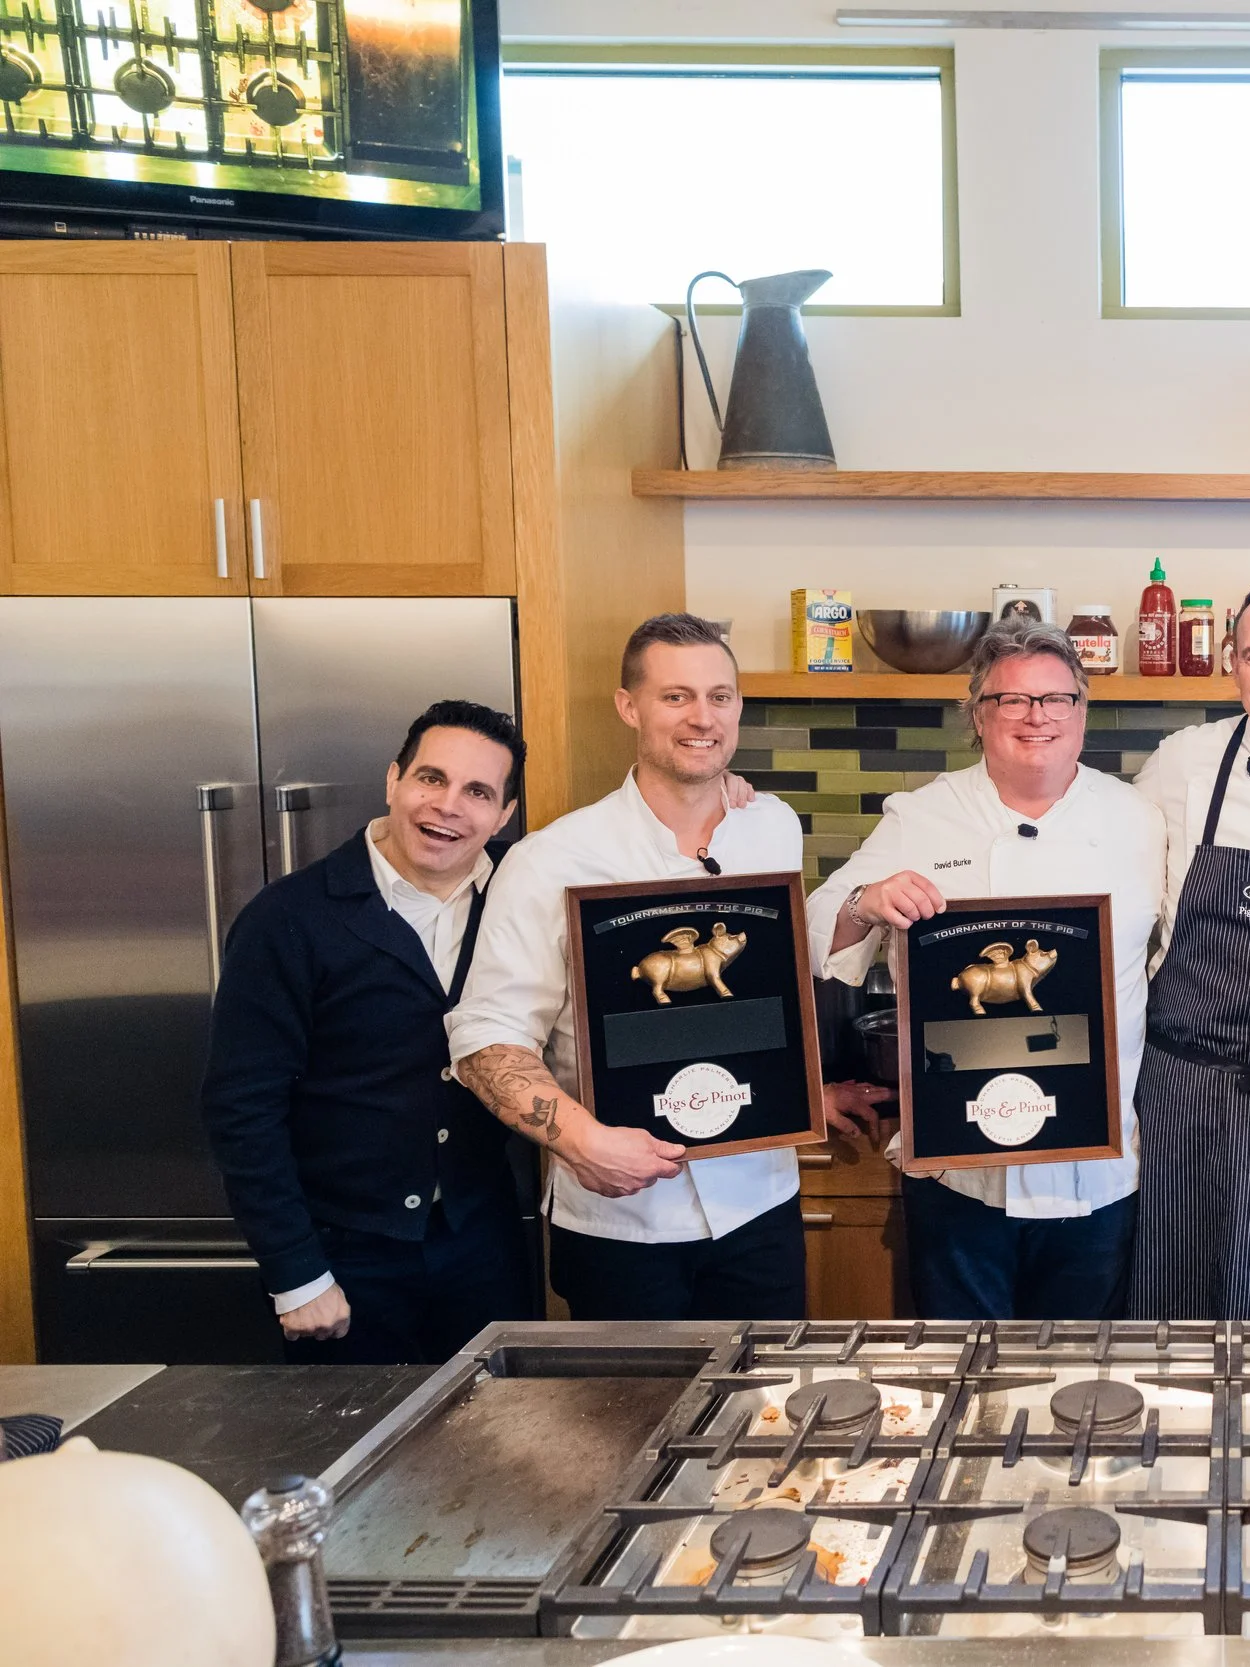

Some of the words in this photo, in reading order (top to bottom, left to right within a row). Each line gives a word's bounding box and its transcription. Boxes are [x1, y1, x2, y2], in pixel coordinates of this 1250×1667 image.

[190, 195, 235, 206] Panasonic
[814, 606, 848, 619] ARGO
[934, 860, 952, 870] David
[953, 858, 972, 867] Burke
[610, 904, 691, 927] TOURNAMENT
[717, 904, 740, 912] THE
[934, 922, 1006, 939] TOURNAMENT
[1056, 926, 1074, 934] PIG
[658, 1097, 686, 1113] Pigs
[689, 1092, 708, 1110] &
[711, 1090, 747, 1104] Pinot
[971, 1104, 996, 1119] Pigs
[998, 1101, 1016, 1118] &
[1019, 1101, 1052, 1113] Pinot
